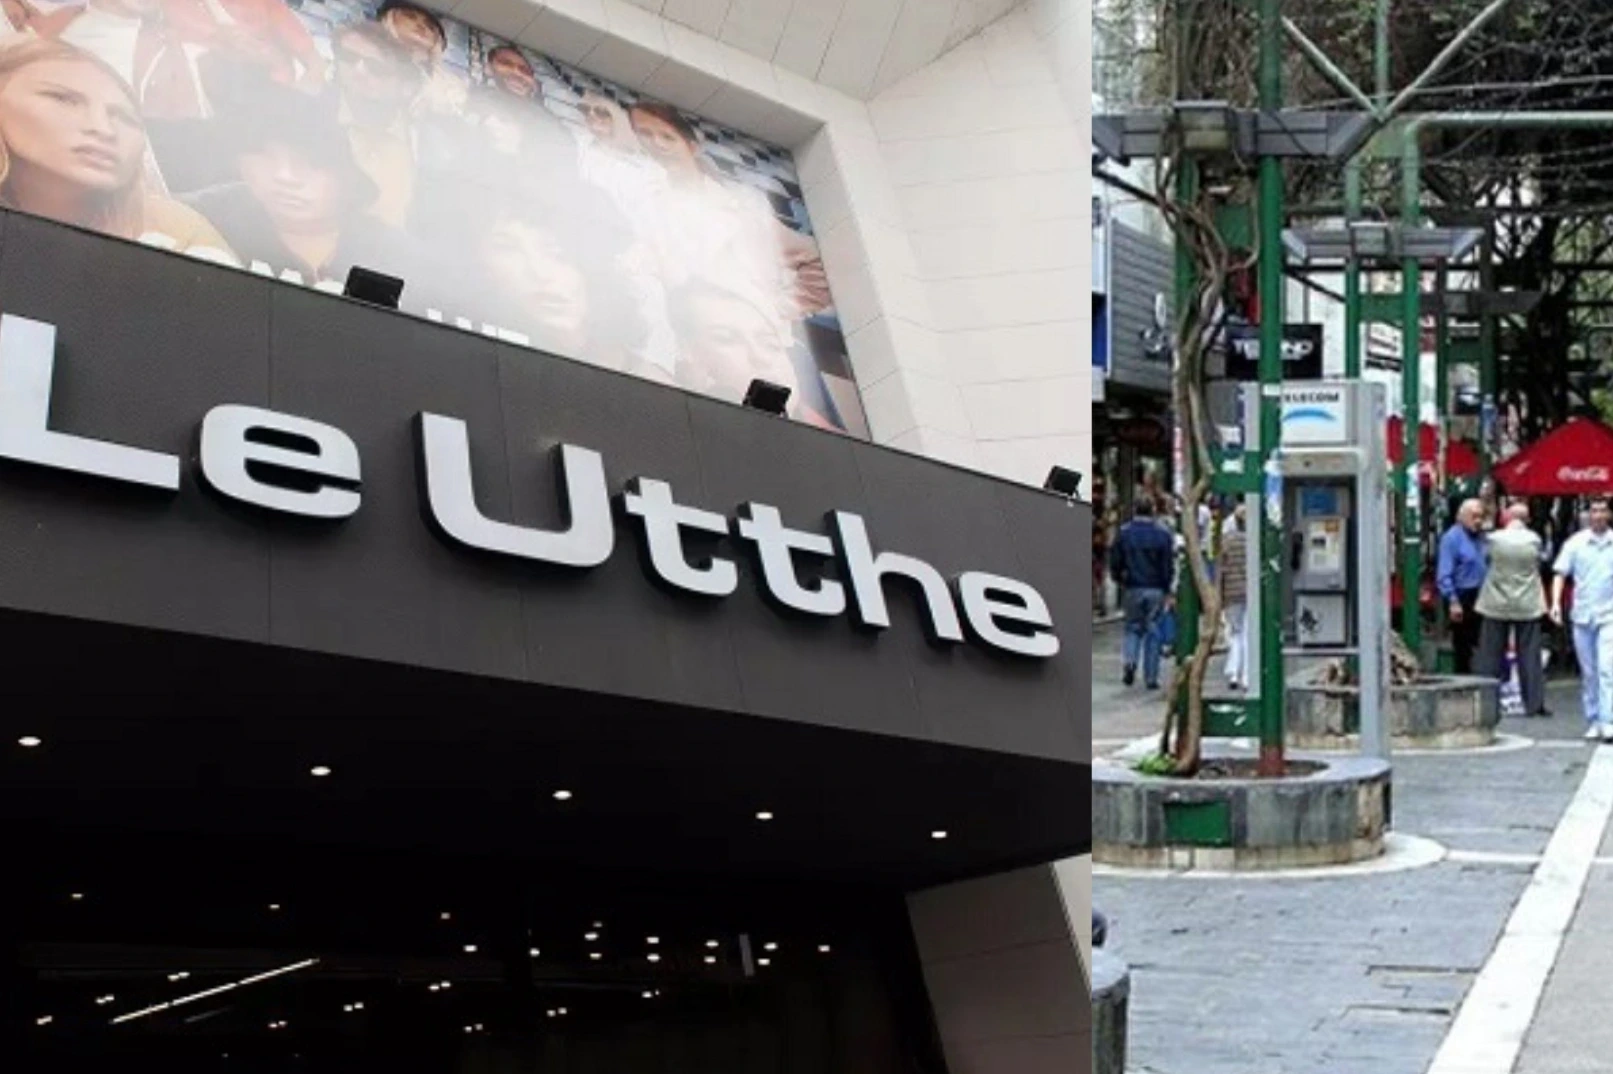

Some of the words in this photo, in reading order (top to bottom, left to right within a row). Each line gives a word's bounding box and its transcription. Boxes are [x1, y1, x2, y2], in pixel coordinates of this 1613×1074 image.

[0, 313, 361, 518] Le
[420, 411, 1060, 657] Utthe
[1283, 391, 1339, 402] ELECOM
